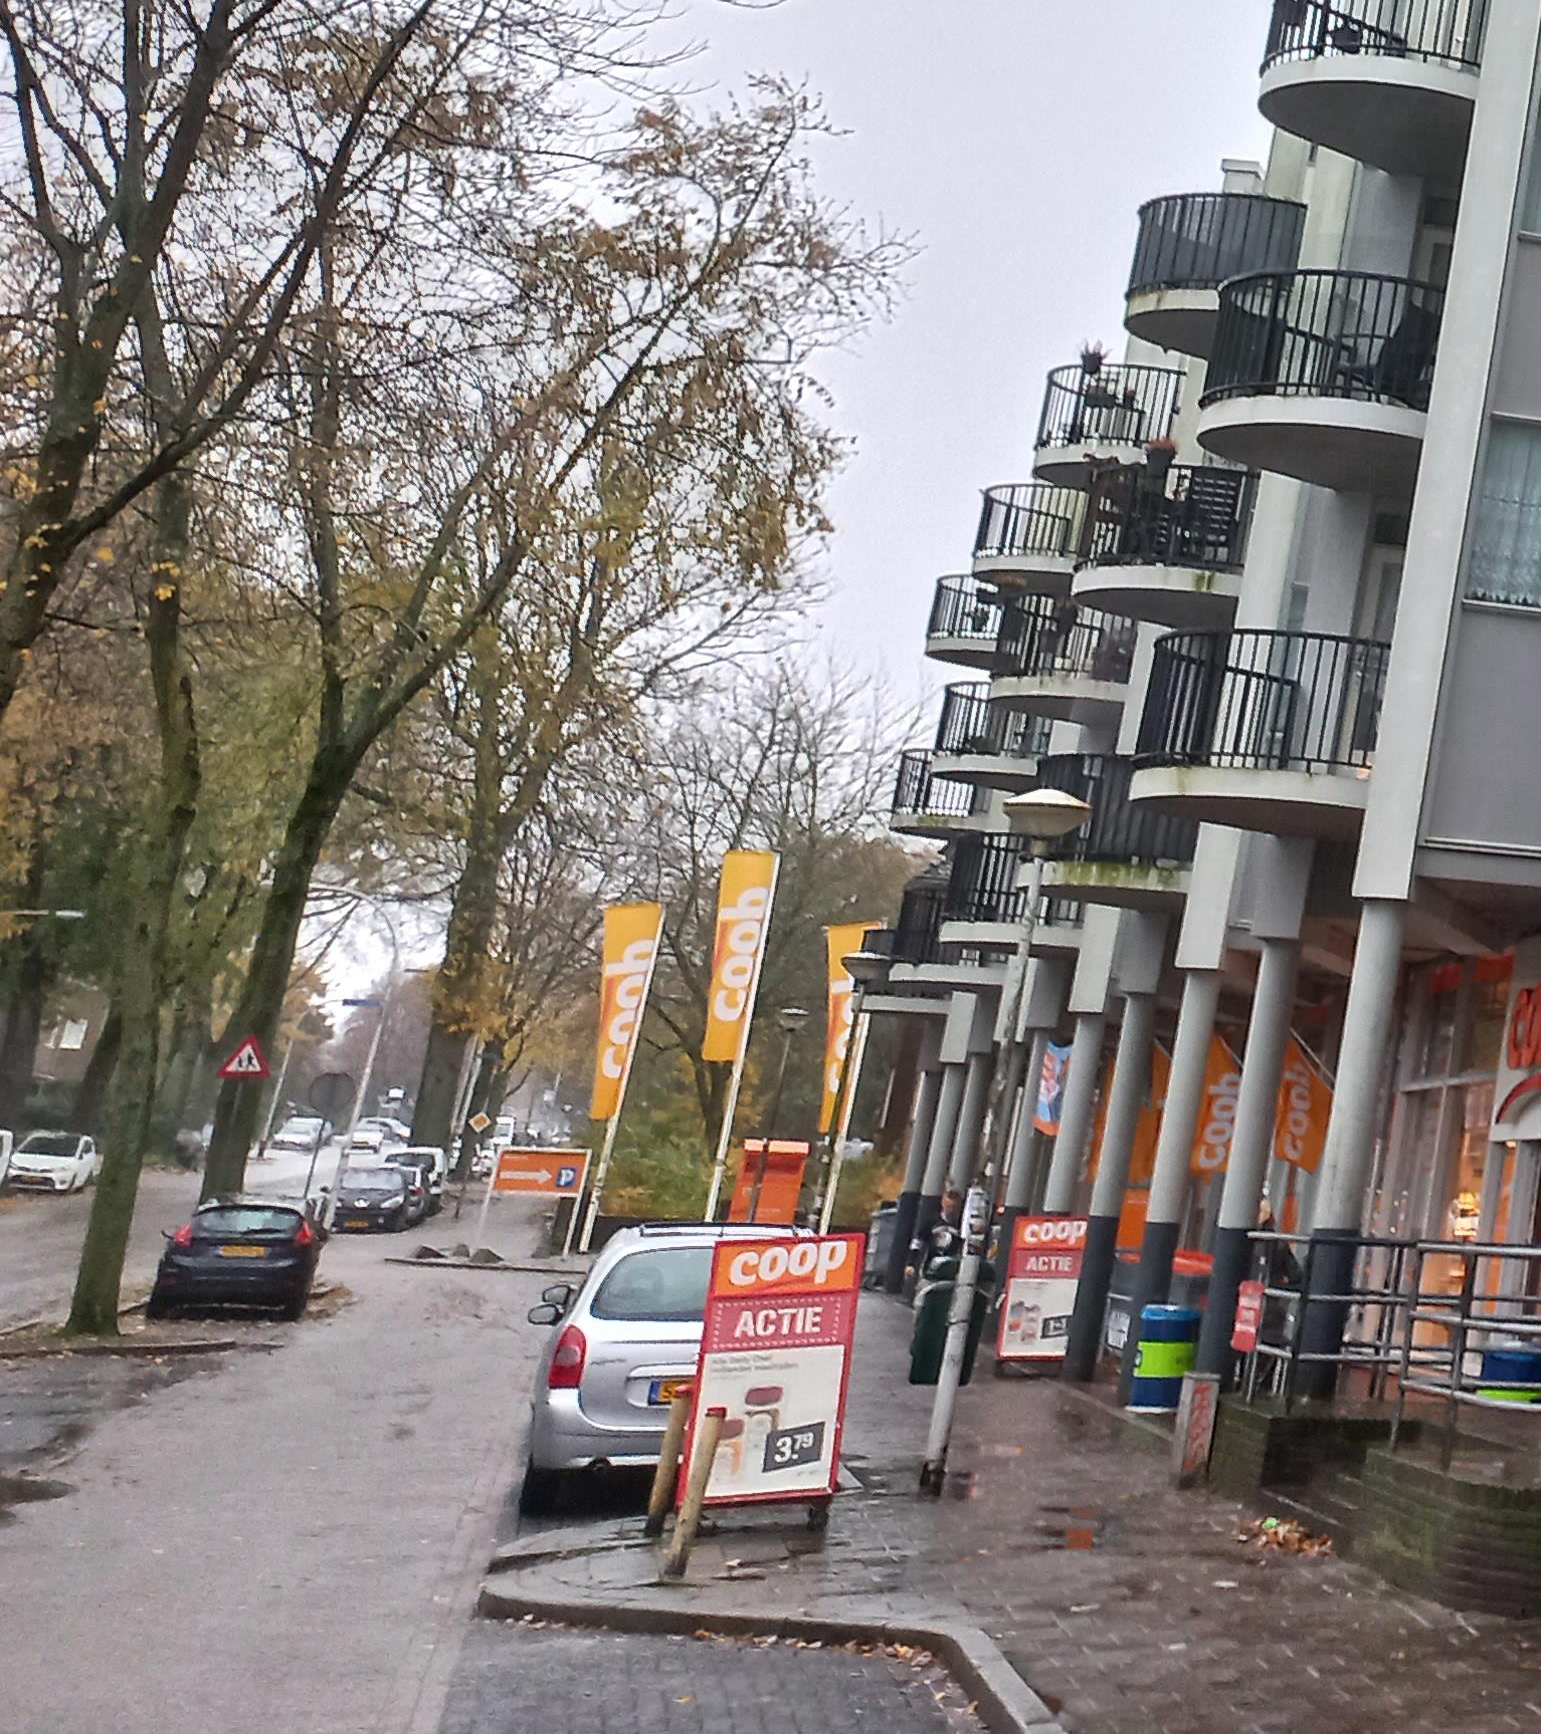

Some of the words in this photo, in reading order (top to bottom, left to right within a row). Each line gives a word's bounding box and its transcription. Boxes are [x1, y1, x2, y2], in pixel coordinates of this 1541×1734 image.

[713, 886, 770, 1022] coop
[603, 938, 656, 1079] coop
[1024, 1221, 1088, 1245] coop
[729, 1240, 847, 1286] coop
[1026, 1256, 1074, 1272] ACTIE
[734, 1307, 823, 1339] ACTIE
